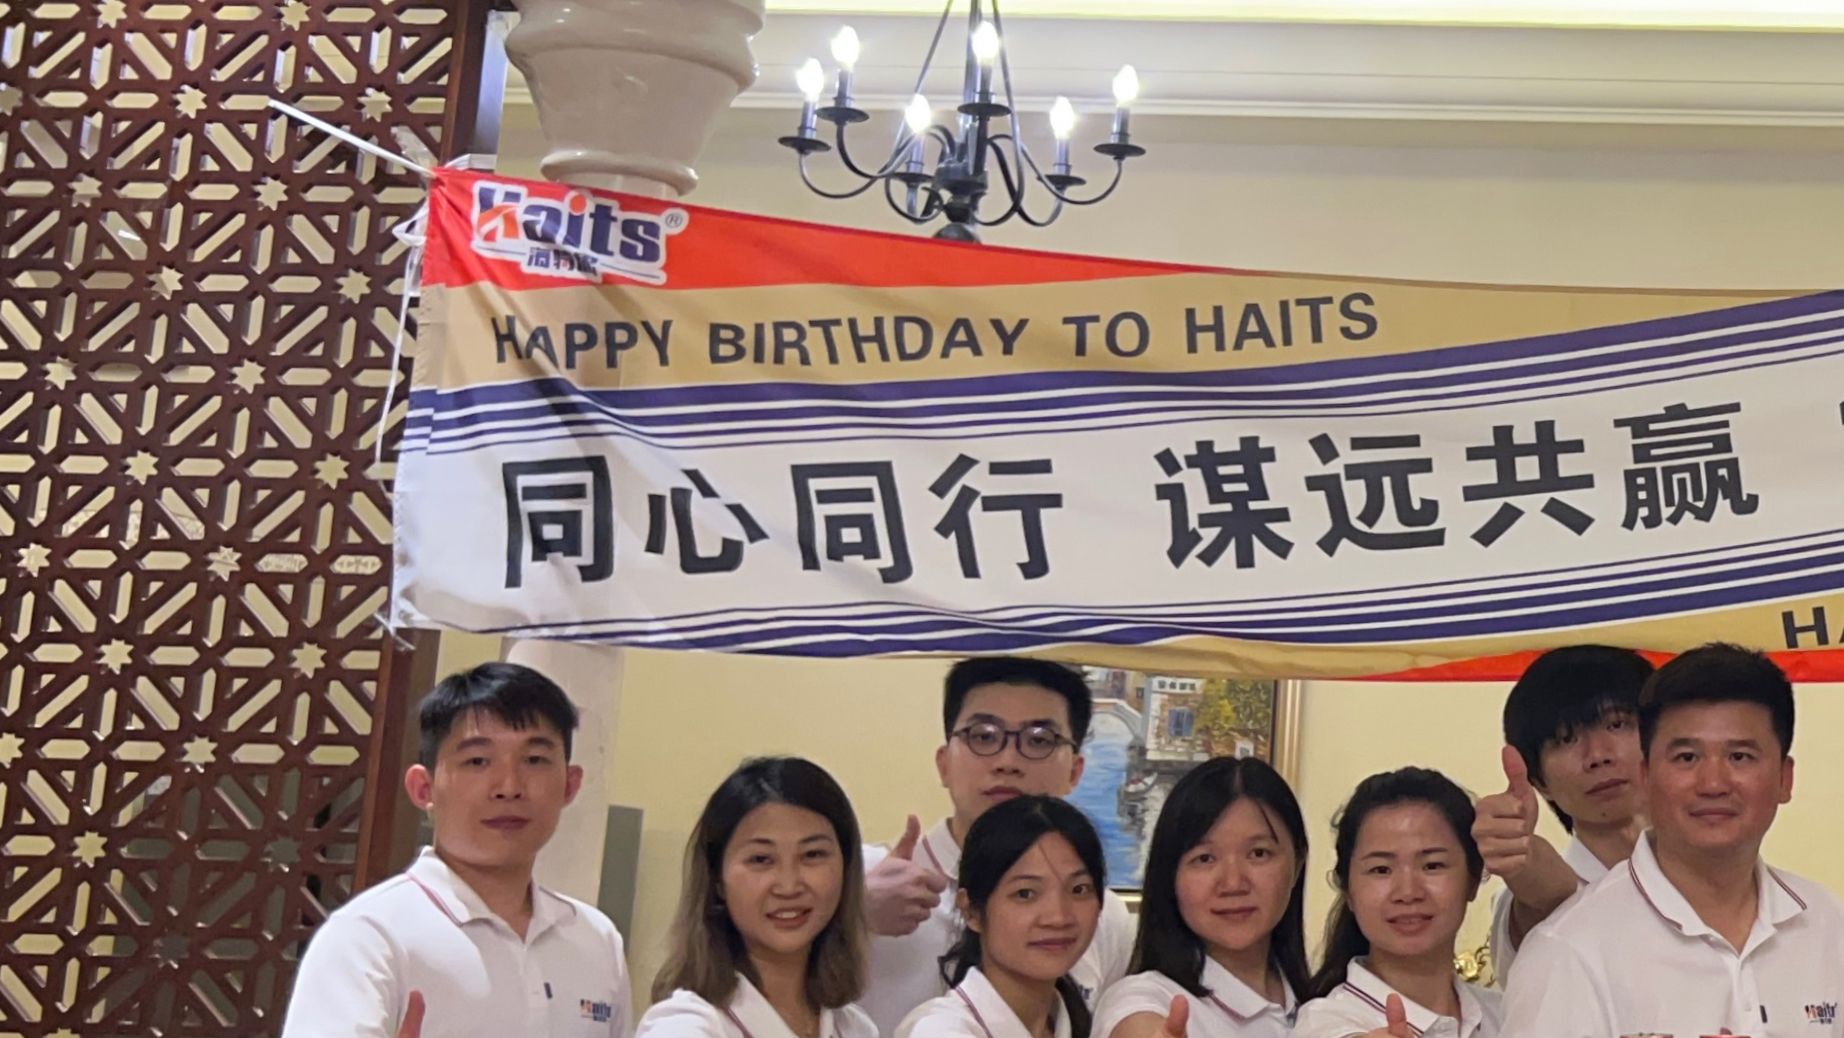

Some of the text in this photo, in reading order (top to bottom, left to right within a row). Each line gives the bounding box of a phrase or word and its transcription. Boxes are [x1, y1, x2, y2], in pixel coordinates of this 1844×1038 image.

[492, 292, 1379, 370] HAPPY BIRTHDAY TO HAITS
[501, 452, 1064, 589] 同心同行
[1153, 401, 1760, 570] 谋远共赢
